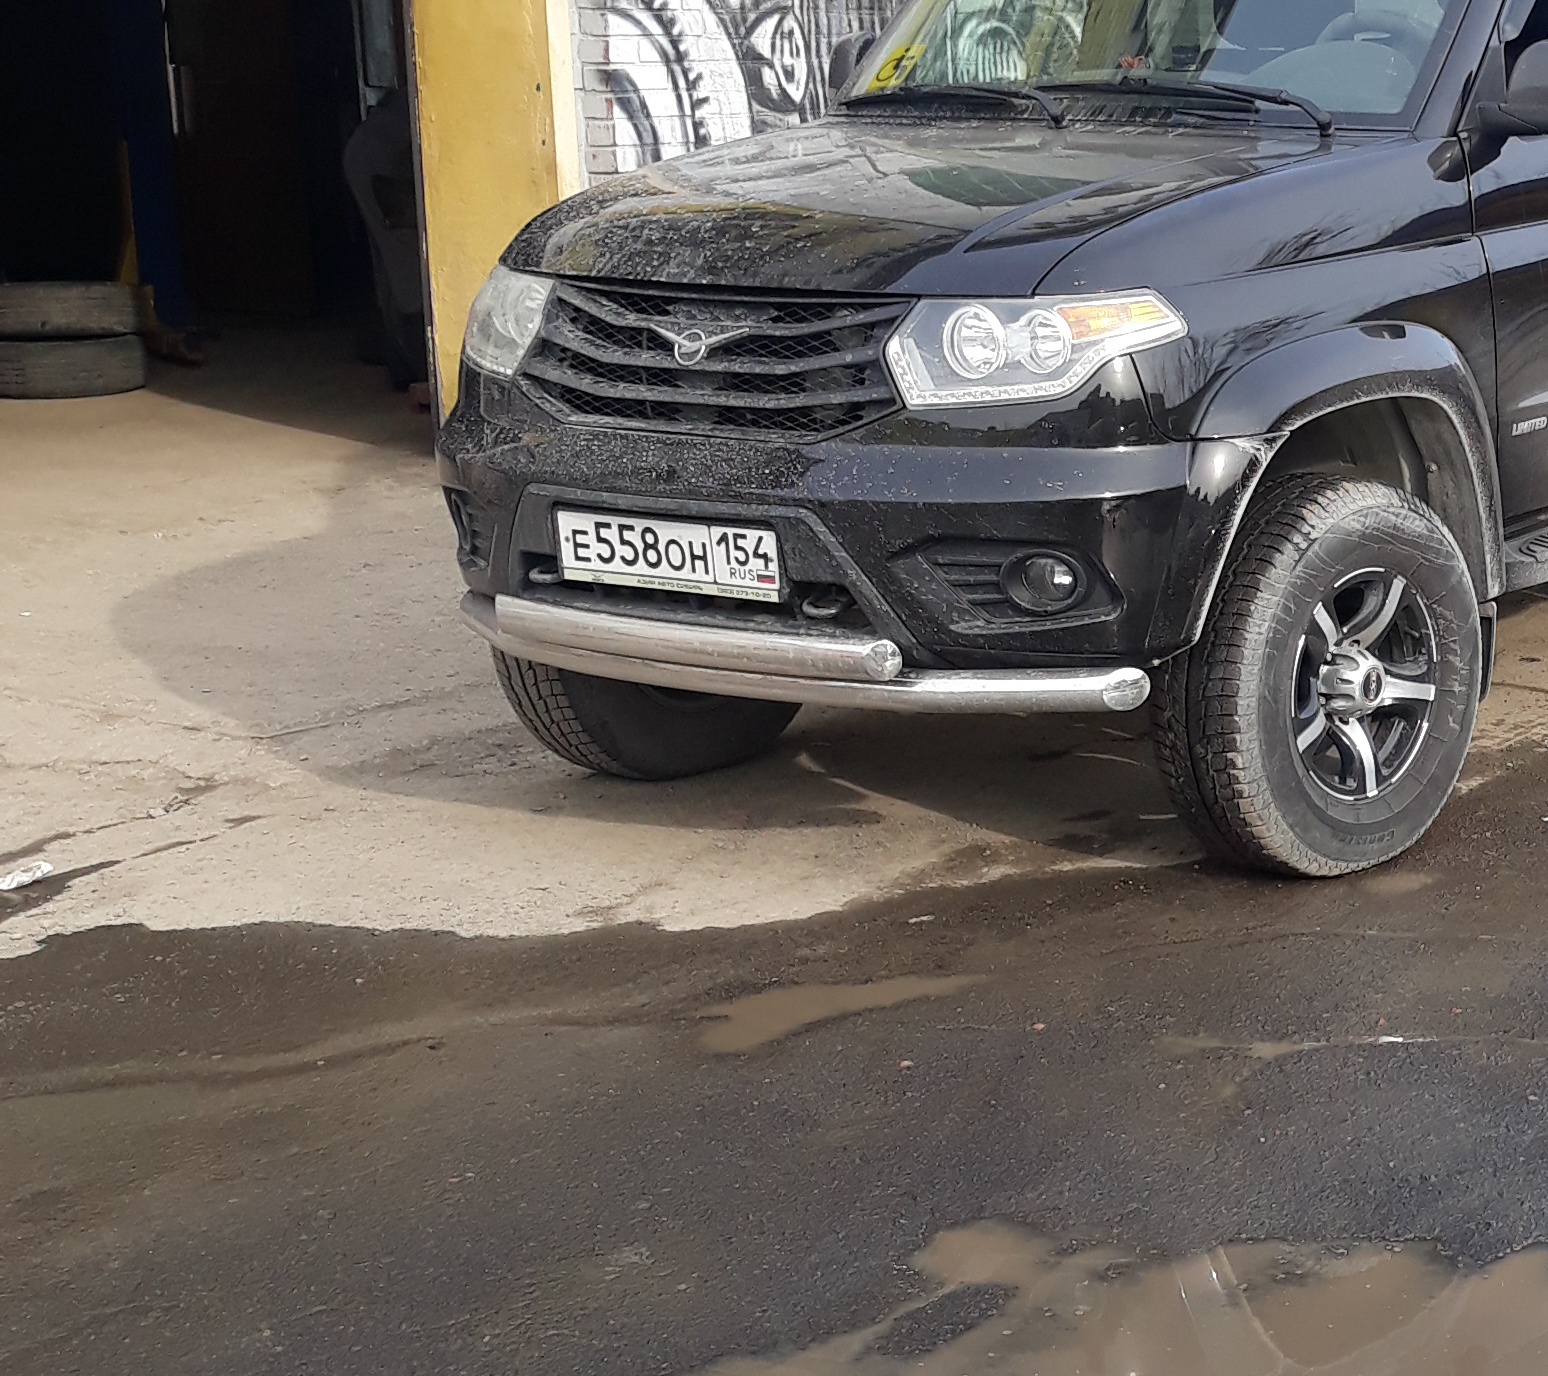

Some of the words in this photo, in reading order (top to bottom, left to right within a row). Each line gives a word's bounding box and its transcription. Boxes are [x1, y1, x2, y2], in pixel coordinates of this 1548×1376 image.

[1511, 416, 1548, 437] LIMITED
[571, 521, 710, 575] Е558ОН
[715, 531, 769, 572] 154
[729, 567, 756, 582] RUS
